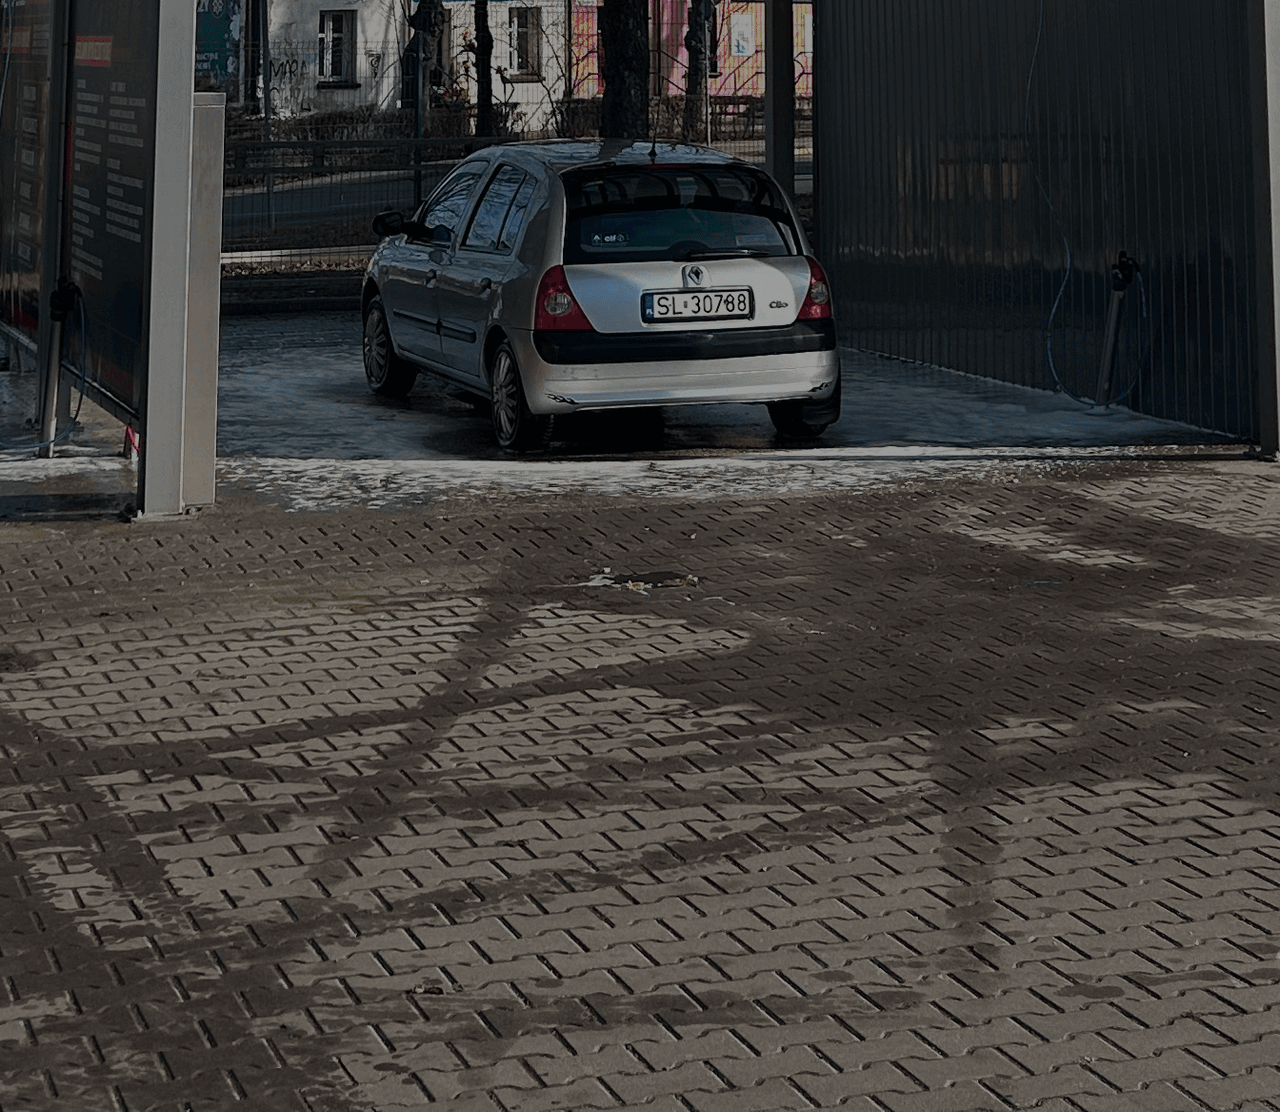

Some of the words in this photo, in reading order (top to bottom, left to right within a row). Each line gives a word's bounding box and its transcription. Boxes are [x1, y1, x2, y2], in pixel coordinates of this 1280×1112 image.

[604, 234, 617, 242] elf
[657, 296, 683, 316] SL
[691, 293, 747, 315] 30788
